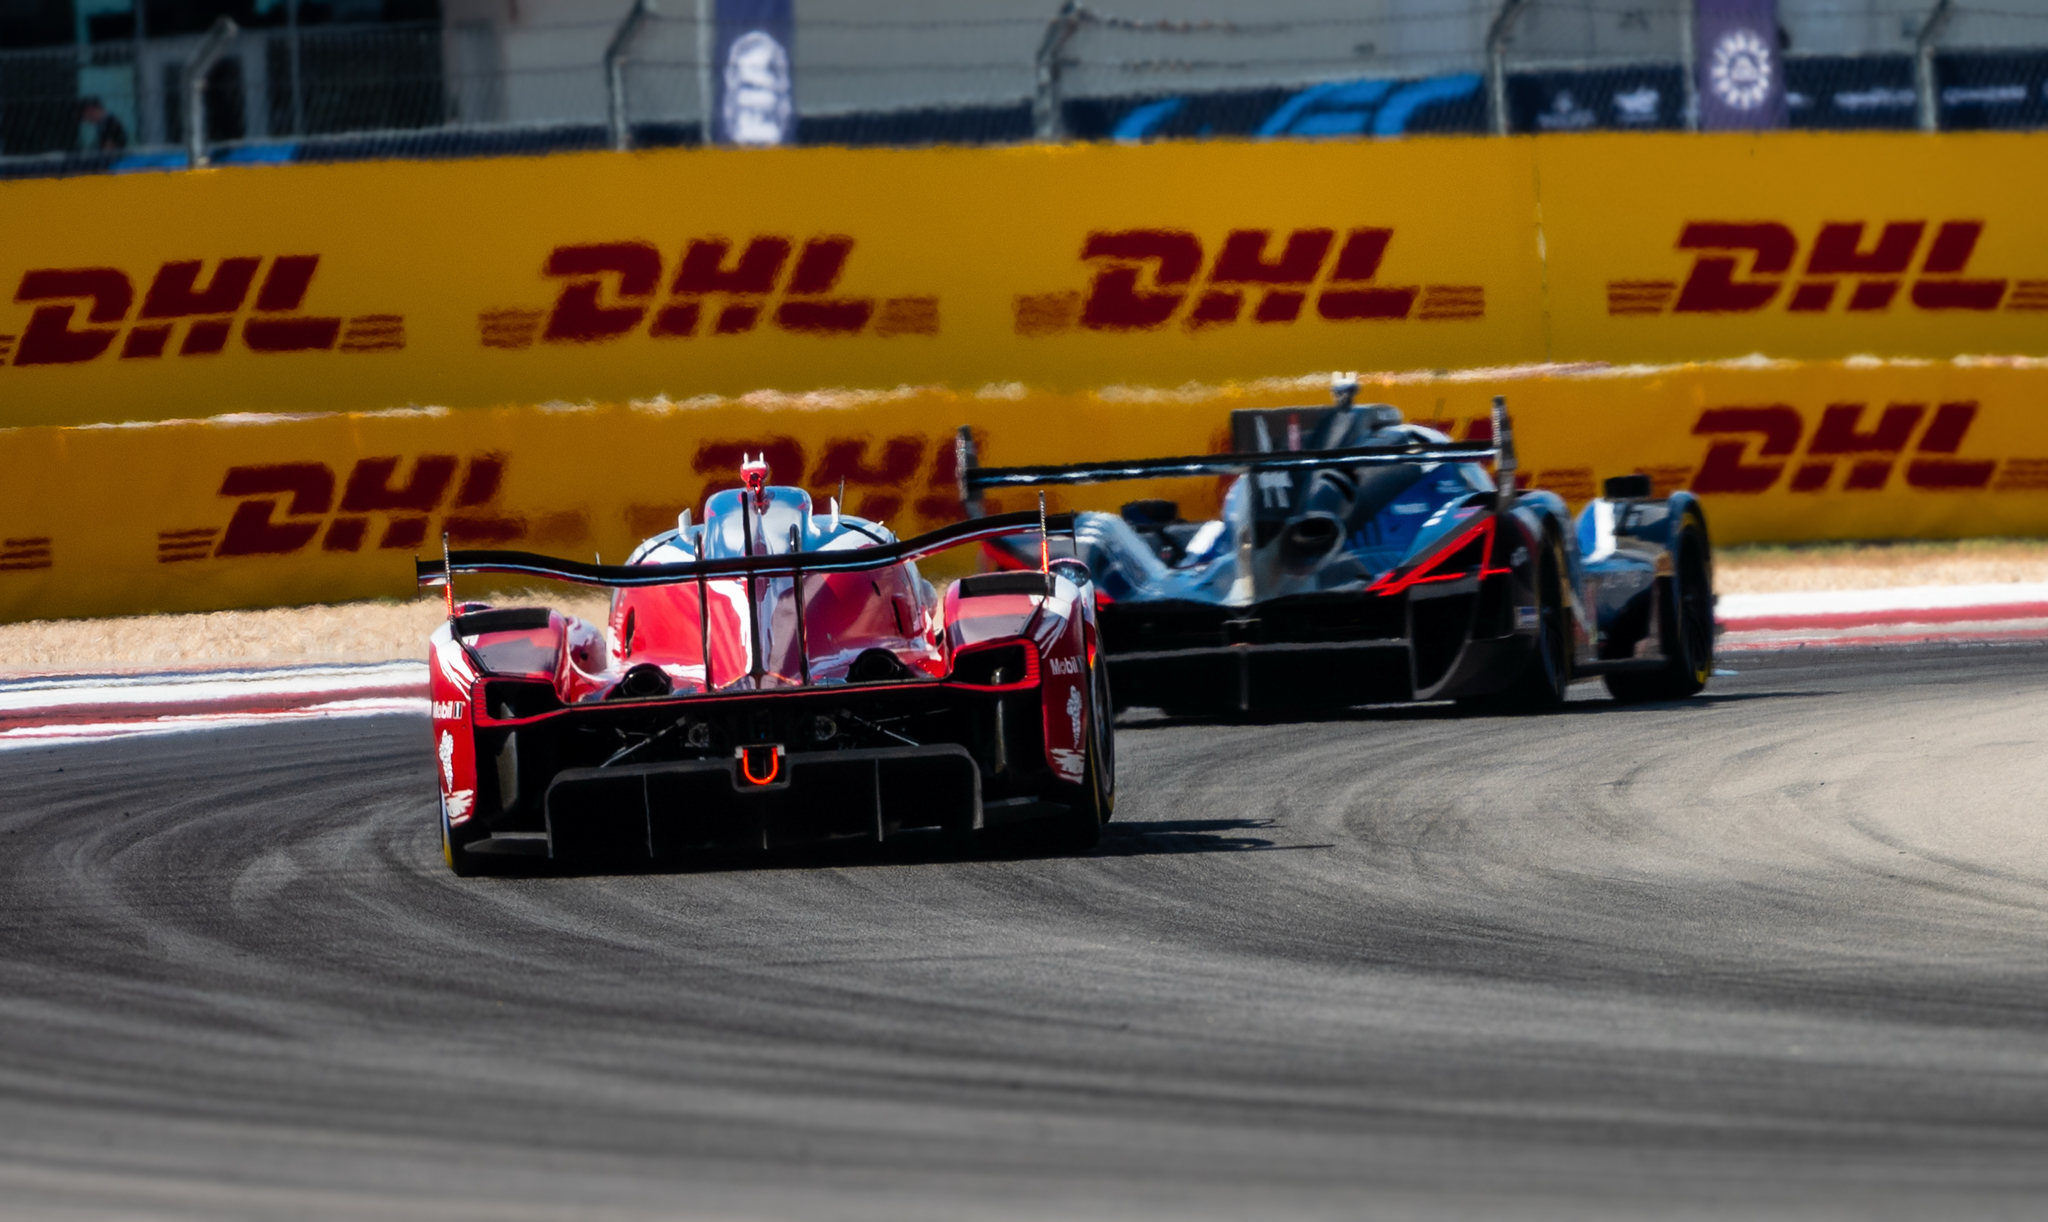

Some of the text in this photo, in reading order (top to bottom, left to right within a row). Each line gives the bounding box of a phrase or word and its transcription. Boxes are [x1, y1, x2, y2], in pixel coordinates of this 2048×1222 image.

[13, 254, 341, 366] DHL
[543, 235, 874, 342] DHL
[1079, 227, 1421, 331] DHL
[1674, 220, 2007, 312] DHL
[1690, 402, 1997, 493] DHL
[214, 453, 528, 556] DHL
